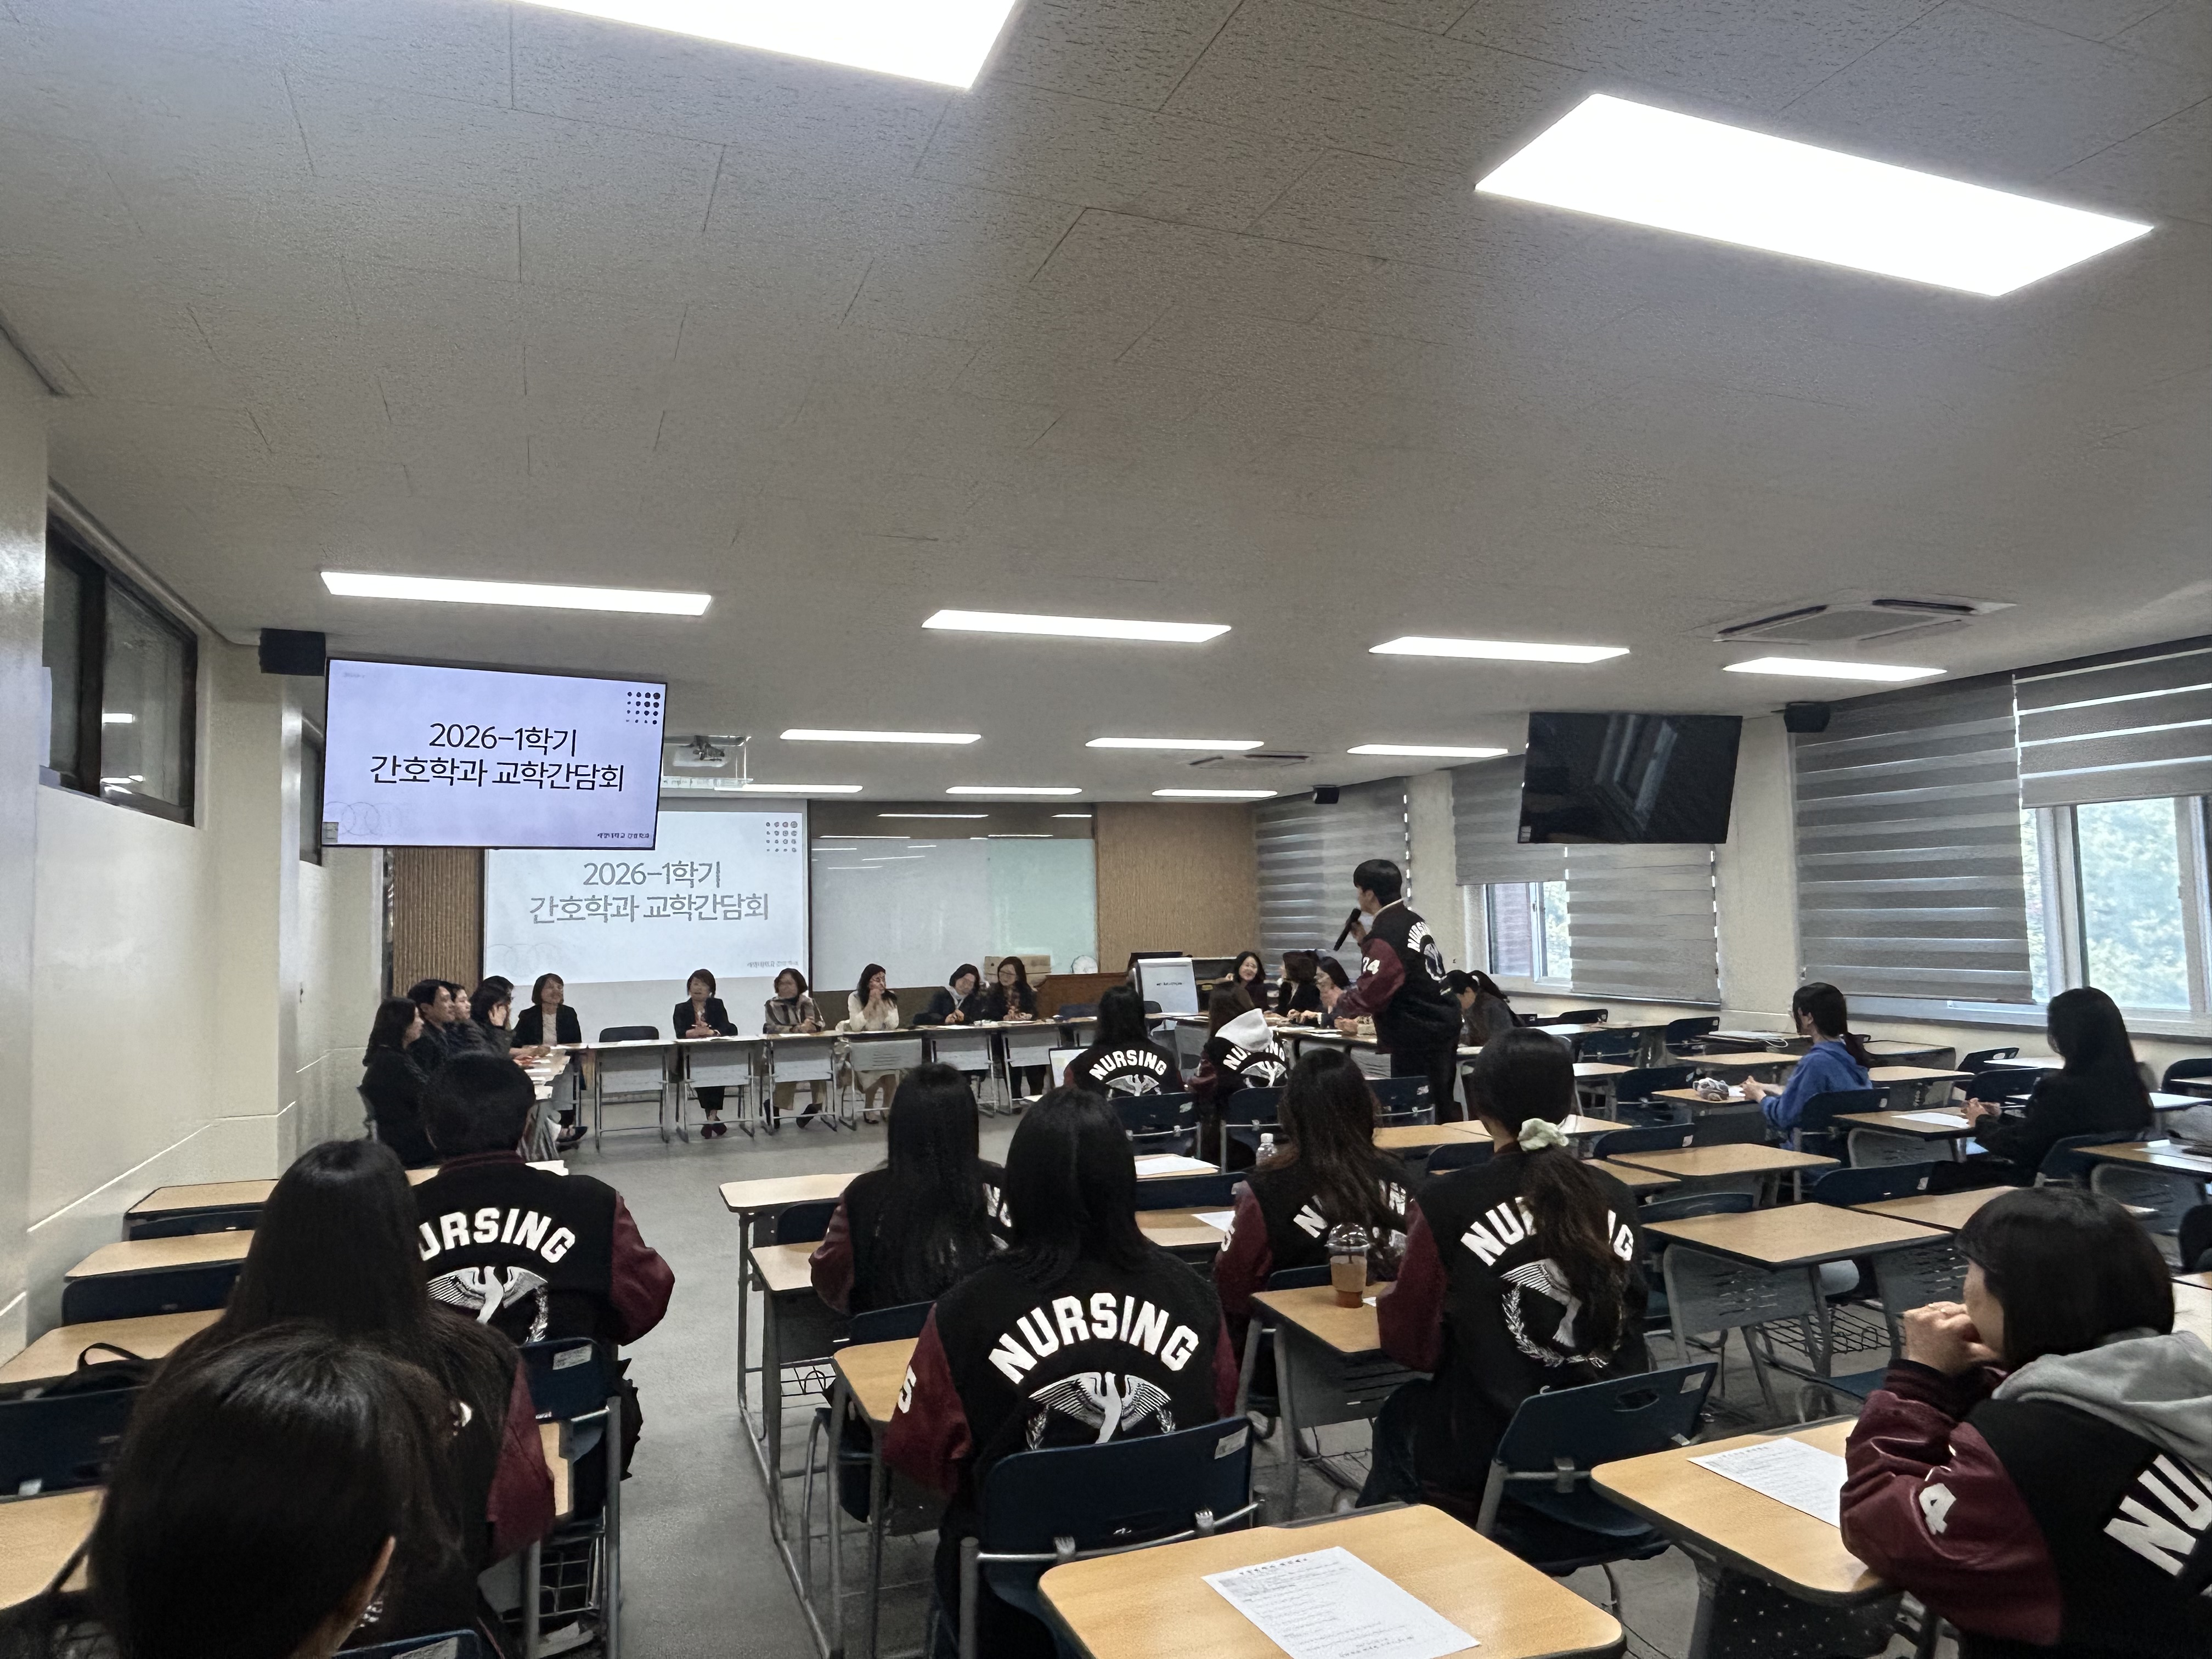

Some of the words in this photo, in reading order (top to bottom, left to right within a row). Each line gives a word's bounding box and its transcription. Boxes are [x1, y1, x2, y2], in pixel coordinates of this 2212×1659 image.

[430, 723, 576, 757] 2026-1학기
[370, 755, 488, 787] 간호학과
[492, 760, 624, 792] 교학간담회
[583, 861, 721, 888] 2026-1학기
[530, 895, 640, 923] 간호학과
[644, 893, 768, 922] 교학간담회
[1089, 1049, 1167, 1080] NURSING
[419, 1207, 575, 1263] URSING
[989, 1293, 1199, 1385] NURSING
